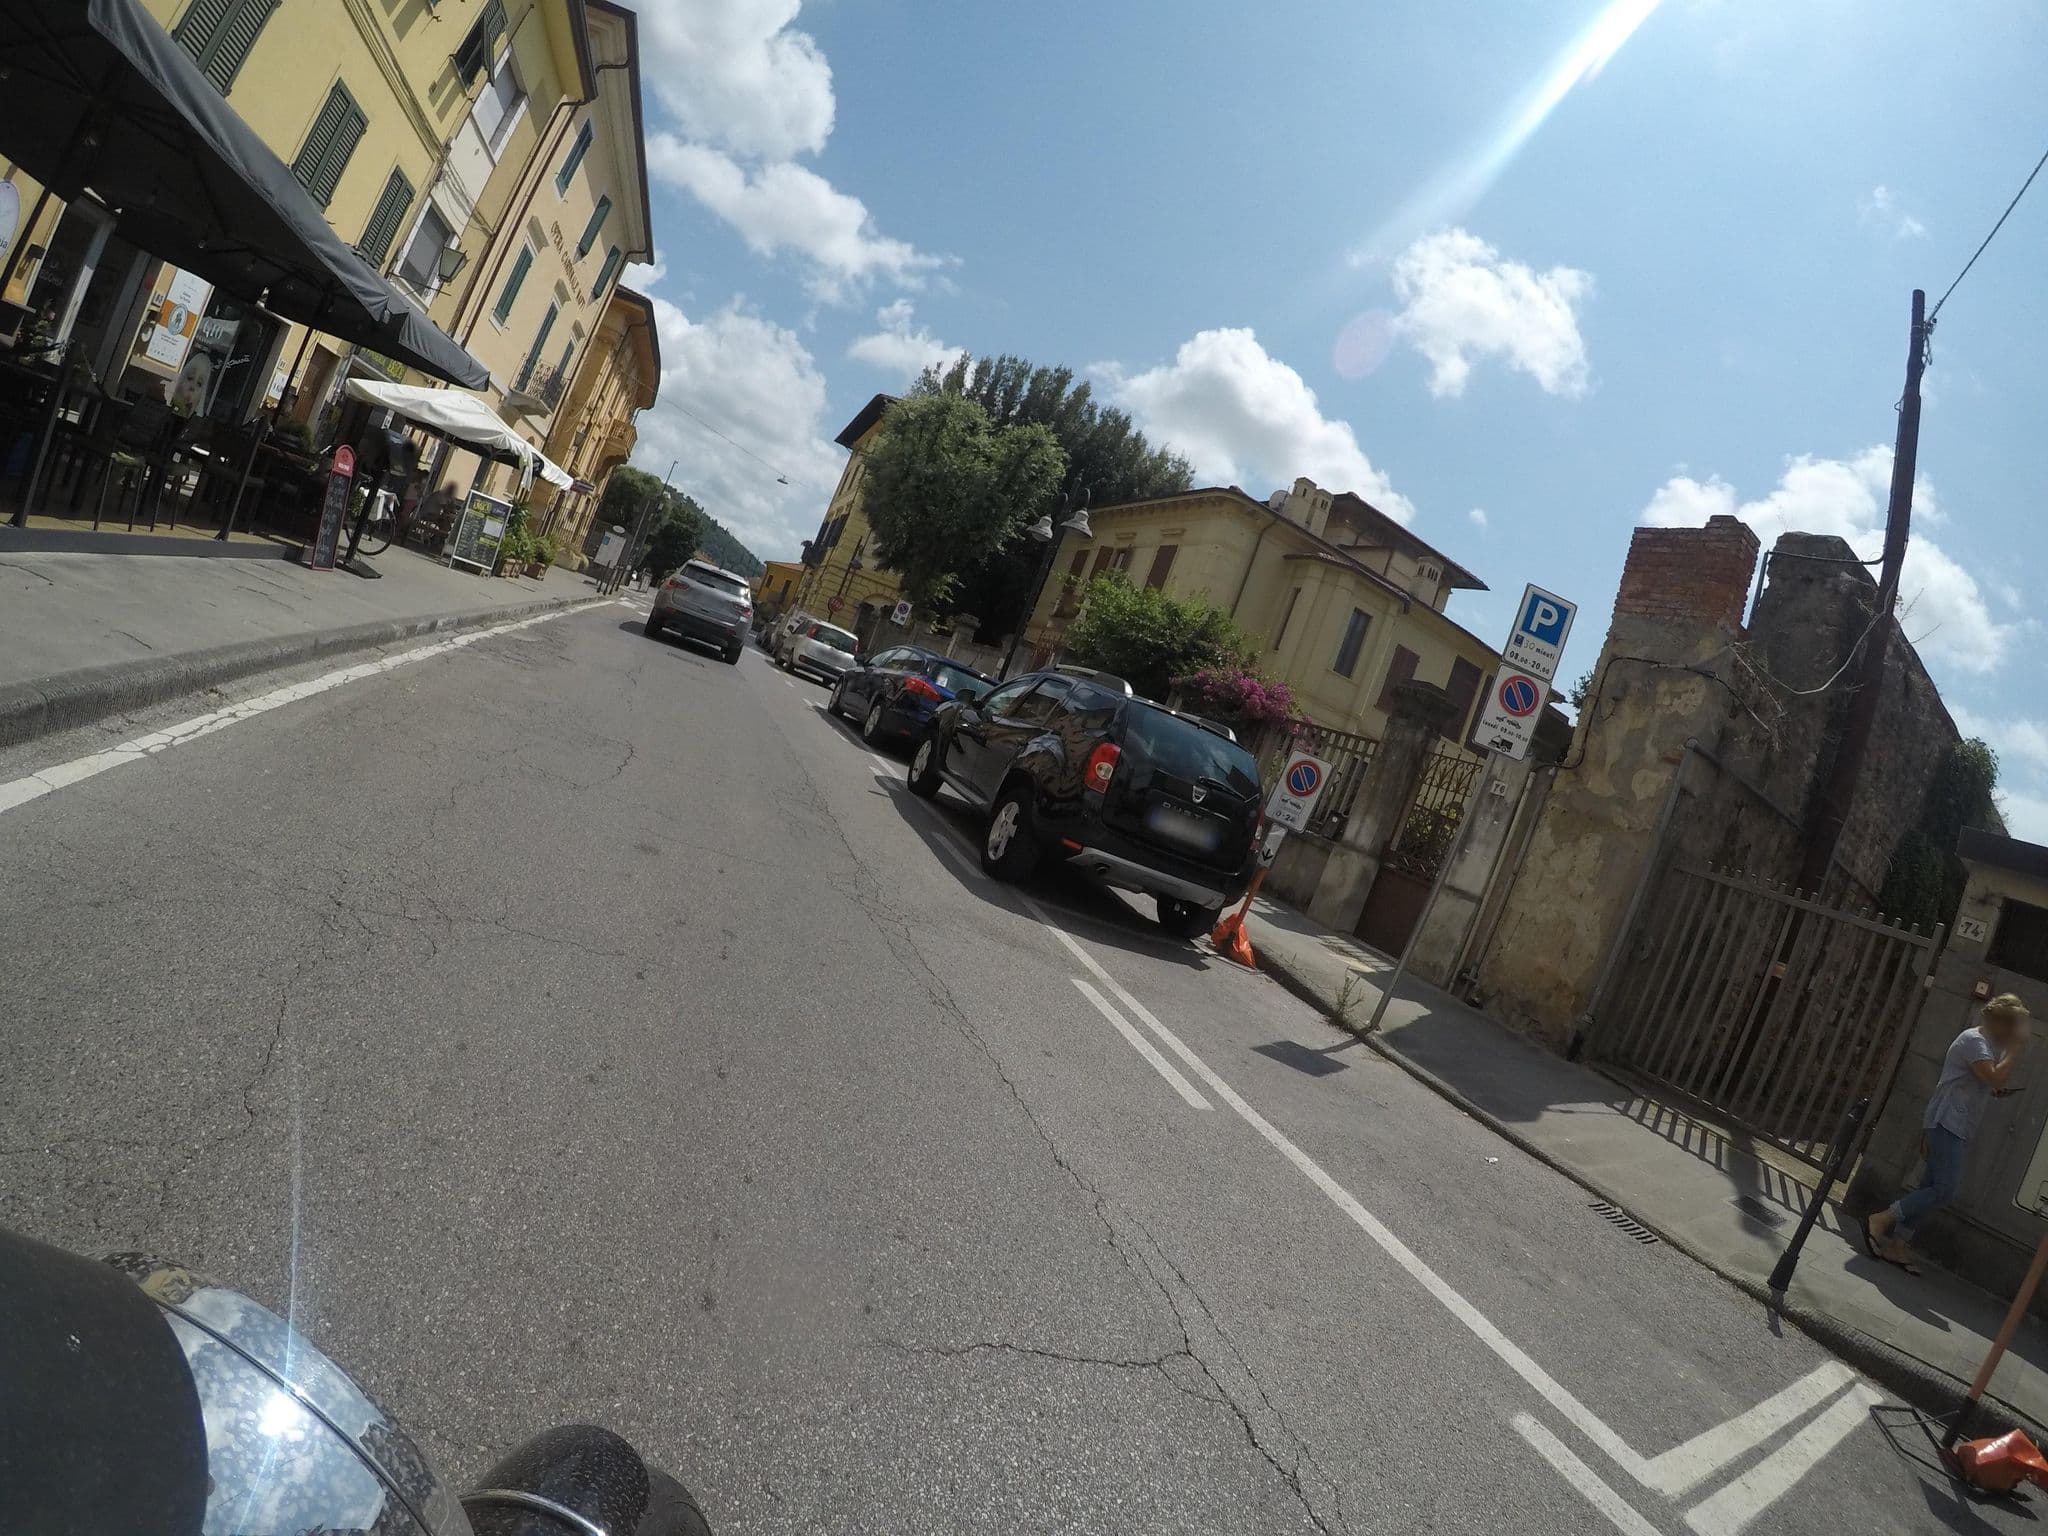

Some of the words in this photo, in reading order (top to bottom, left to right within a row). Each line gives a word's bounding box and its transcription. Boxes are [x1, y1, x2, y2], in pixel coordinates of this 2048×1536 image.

[1529, 600, 1559, 633] P
[1523, 639, 1537, 651] 30
[1962, 921, 1982, 938] 74
